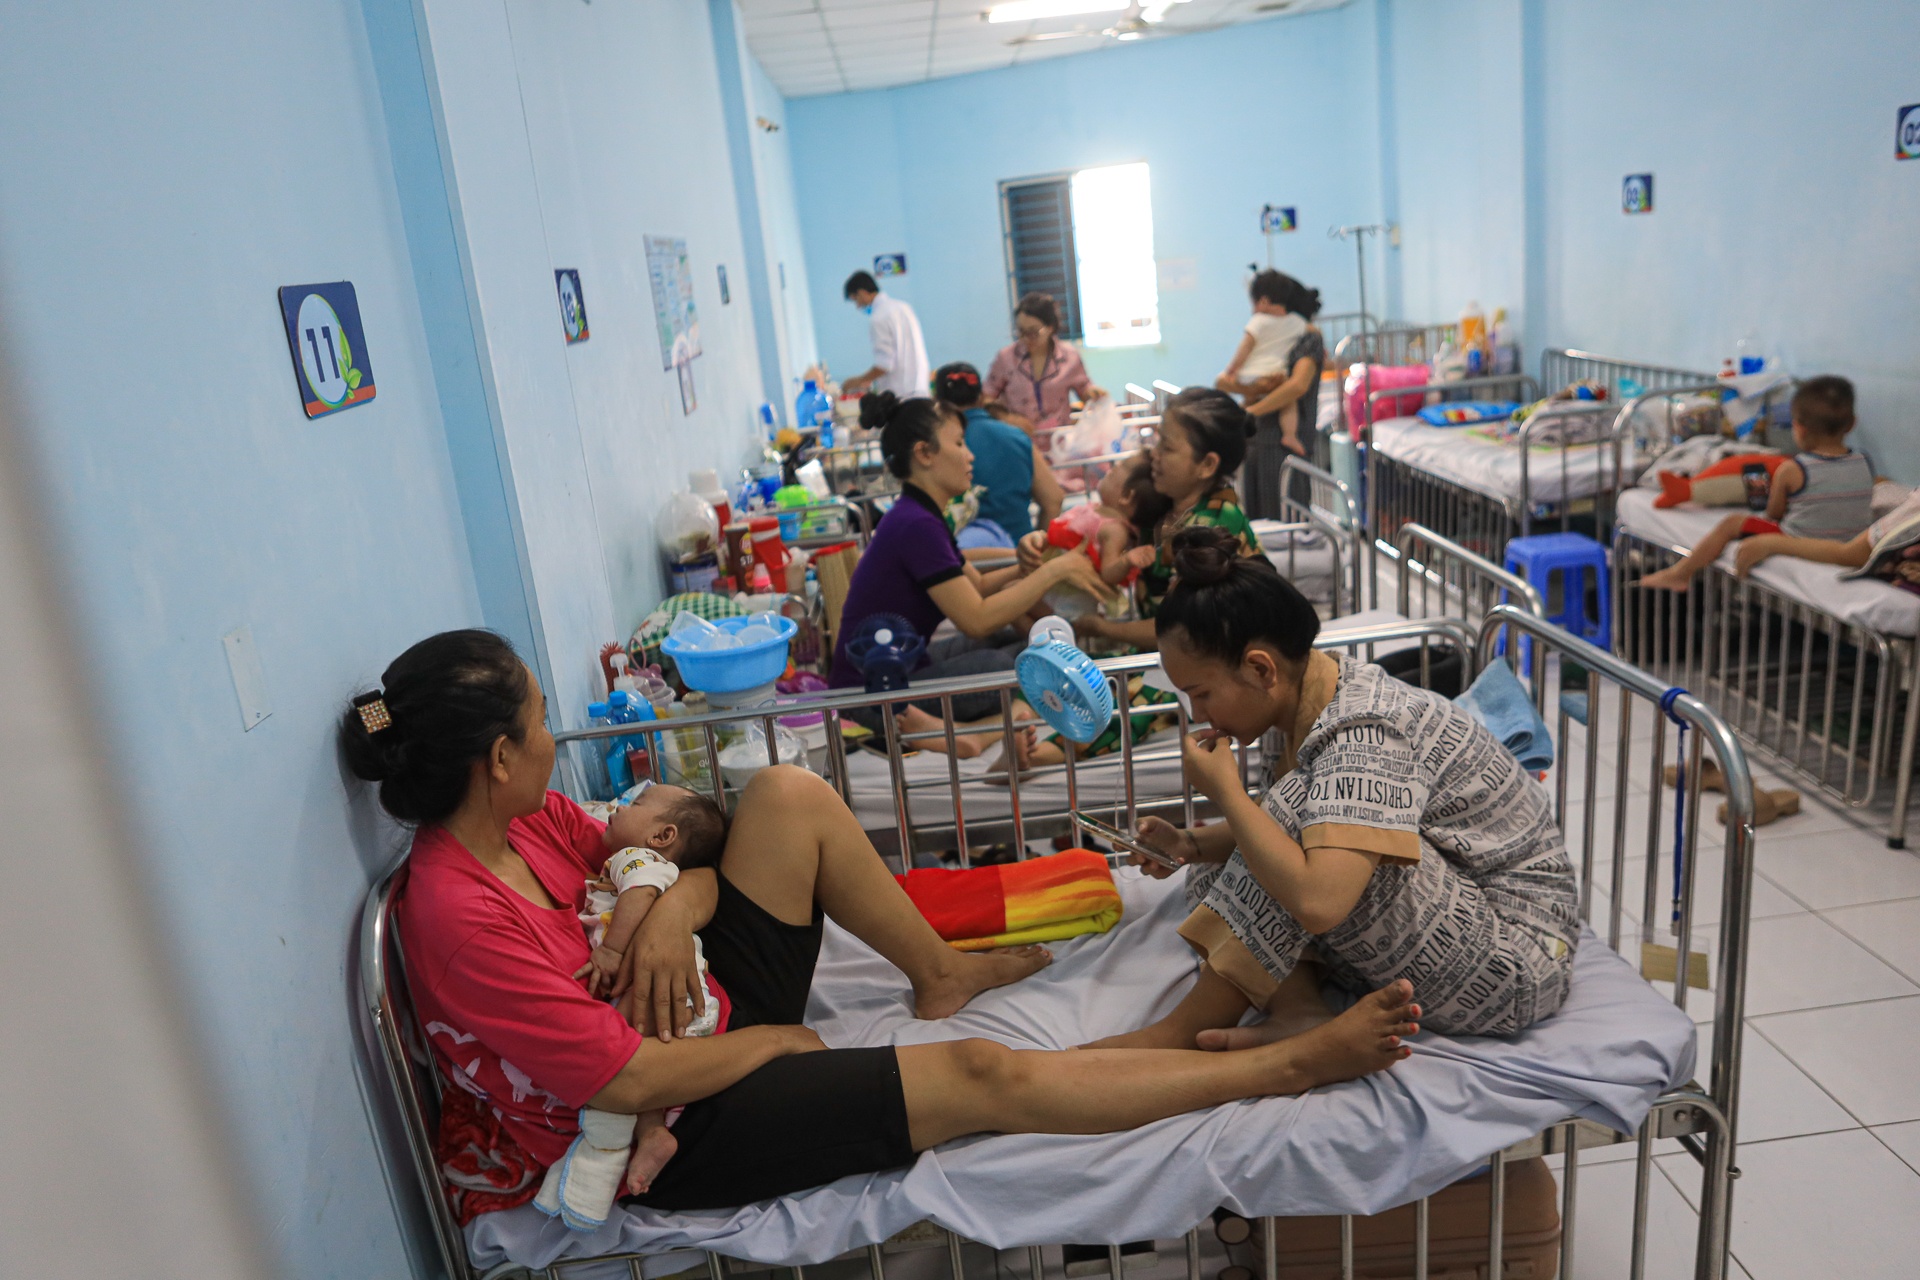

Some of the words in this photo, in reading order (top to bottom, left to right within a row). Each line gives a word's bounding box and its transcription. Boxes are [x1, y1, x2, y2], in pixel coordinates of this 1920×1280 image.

[306, 326, 340, 383] 11
[1343, 724, 1385, 746] TOTO
[1344, 753, 1368, 766] TOTO
[1379, 757, 1415, 776] CHRISTIAN
[1334, 776, 1413, 809] CHRISTIAN
[1318, 804, 1341, 817] TOTO
[1342, 805, 1385, 823] CHRISTIAN
[1457, 975, 1498, 1010] TOTO
